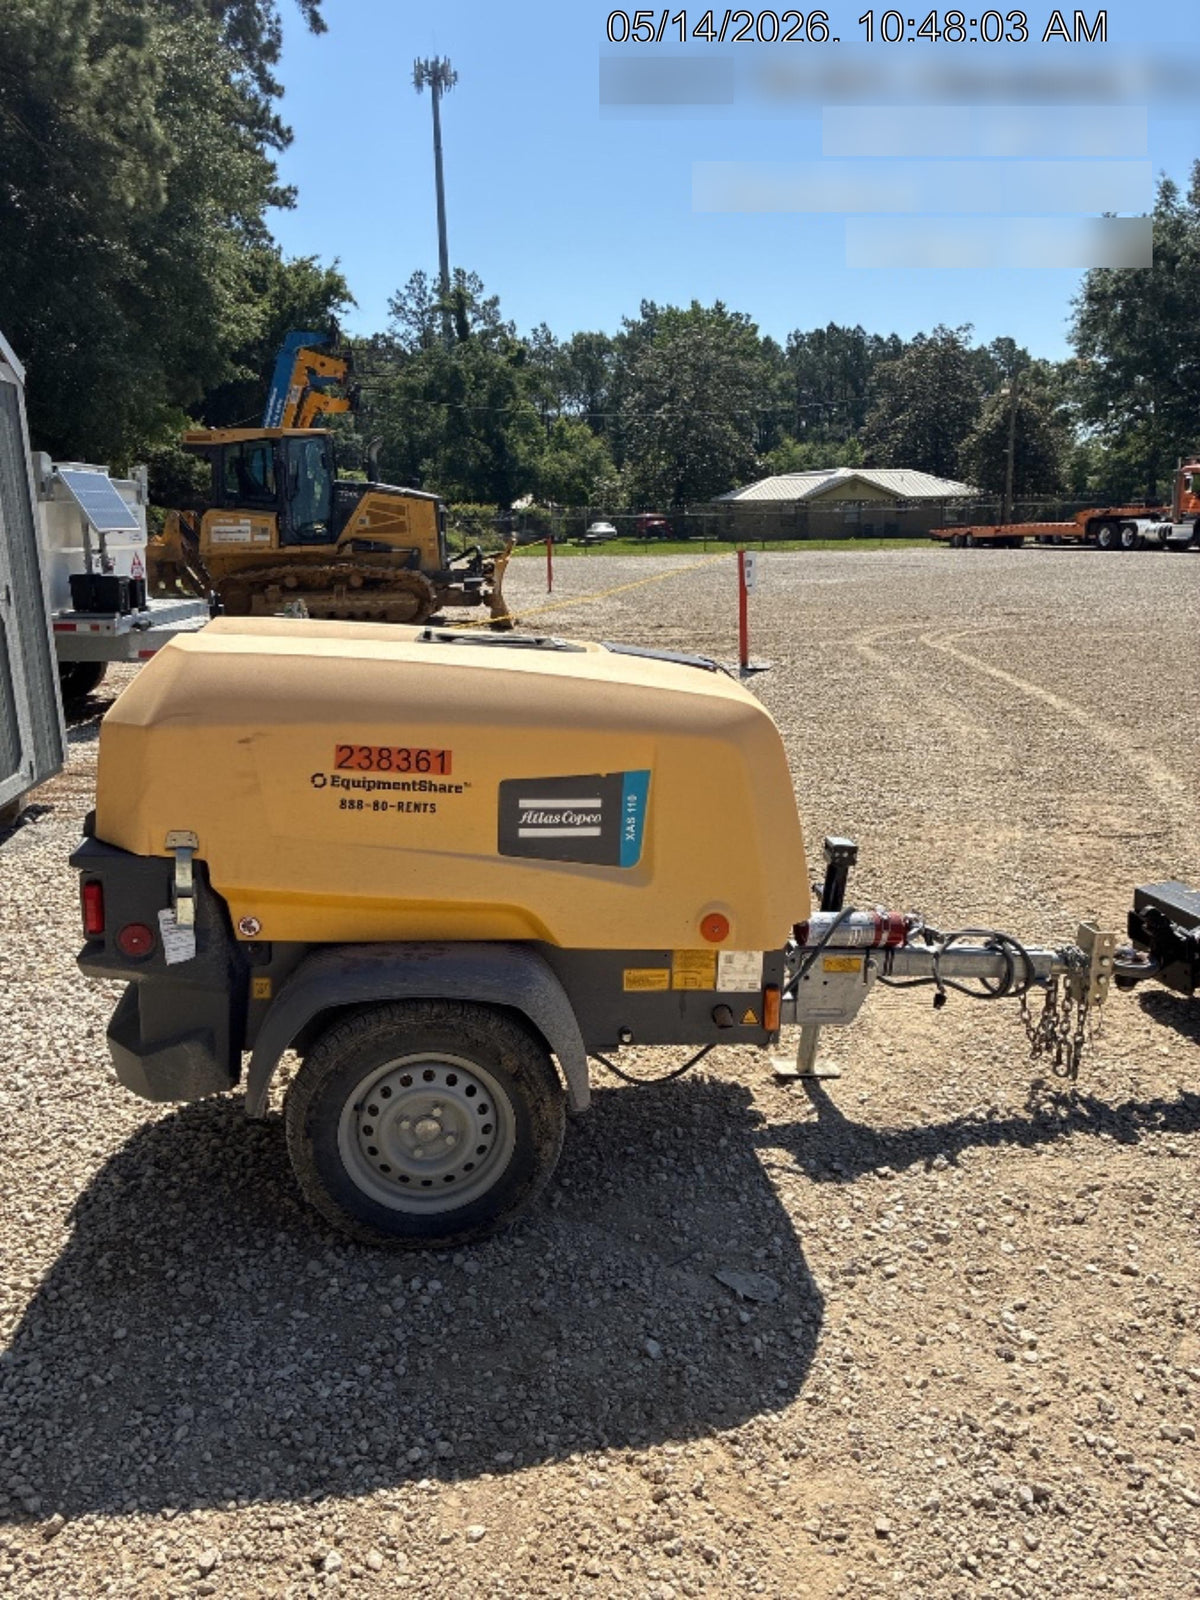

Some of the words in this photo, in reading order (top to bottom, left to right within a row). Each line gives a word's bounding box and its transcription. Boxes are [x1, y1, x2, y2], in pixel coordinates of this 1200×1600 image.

[337, 745, 446, 774] 238361
[330, 774, 463, 794] EquipmentShare
[339, 798, 437, 814] 888-80-RENTS
[627, 794, 638, 813] 110
[518, 810, 560, 825] Atlas
[561, 810, 602, 826] Copco
[625, 816, 636, 842] XAS
